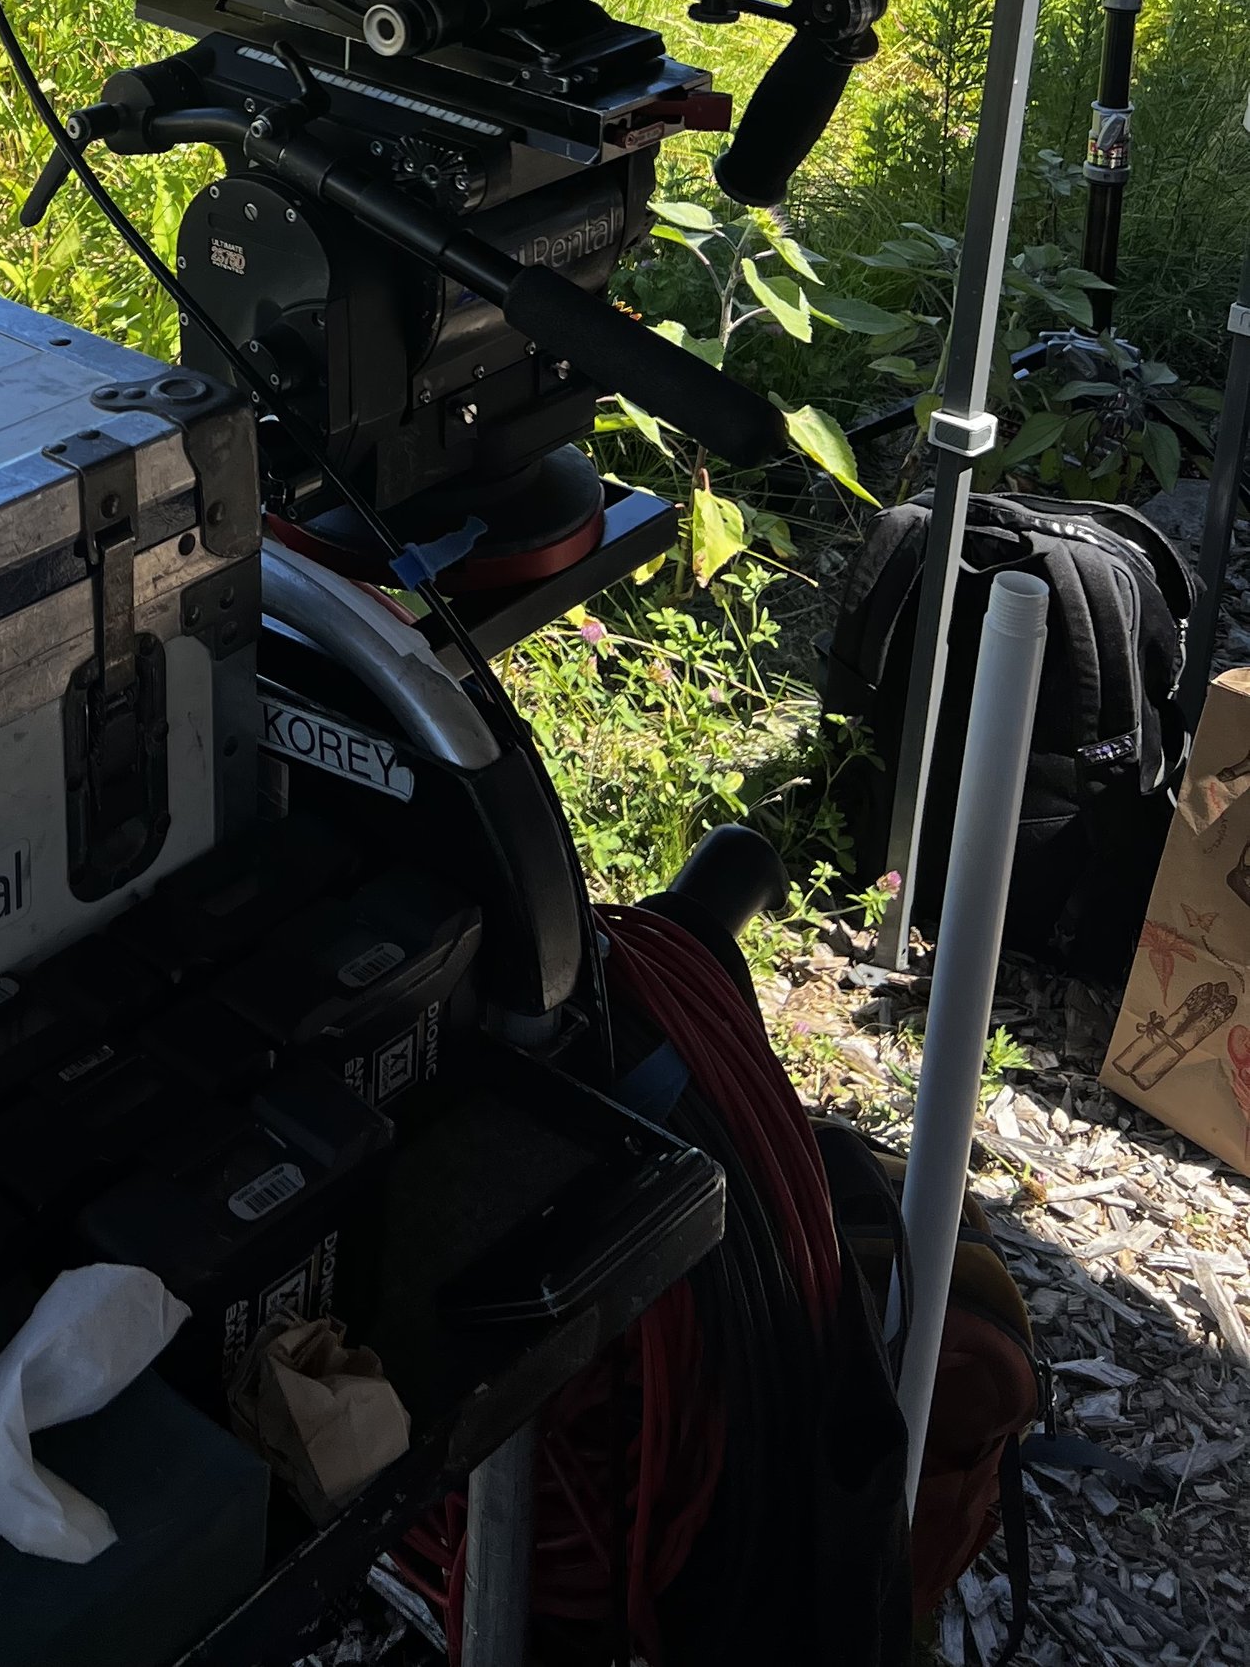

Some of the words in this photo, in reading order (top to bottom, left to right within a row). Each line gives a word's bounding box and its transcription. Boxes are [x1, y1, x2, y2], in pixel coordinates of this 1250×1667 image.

[532, 206, 616, 268] Rental
[262, 702, 398, 787] KOREY
[425, 1000, 440, 1081] DIONIC
